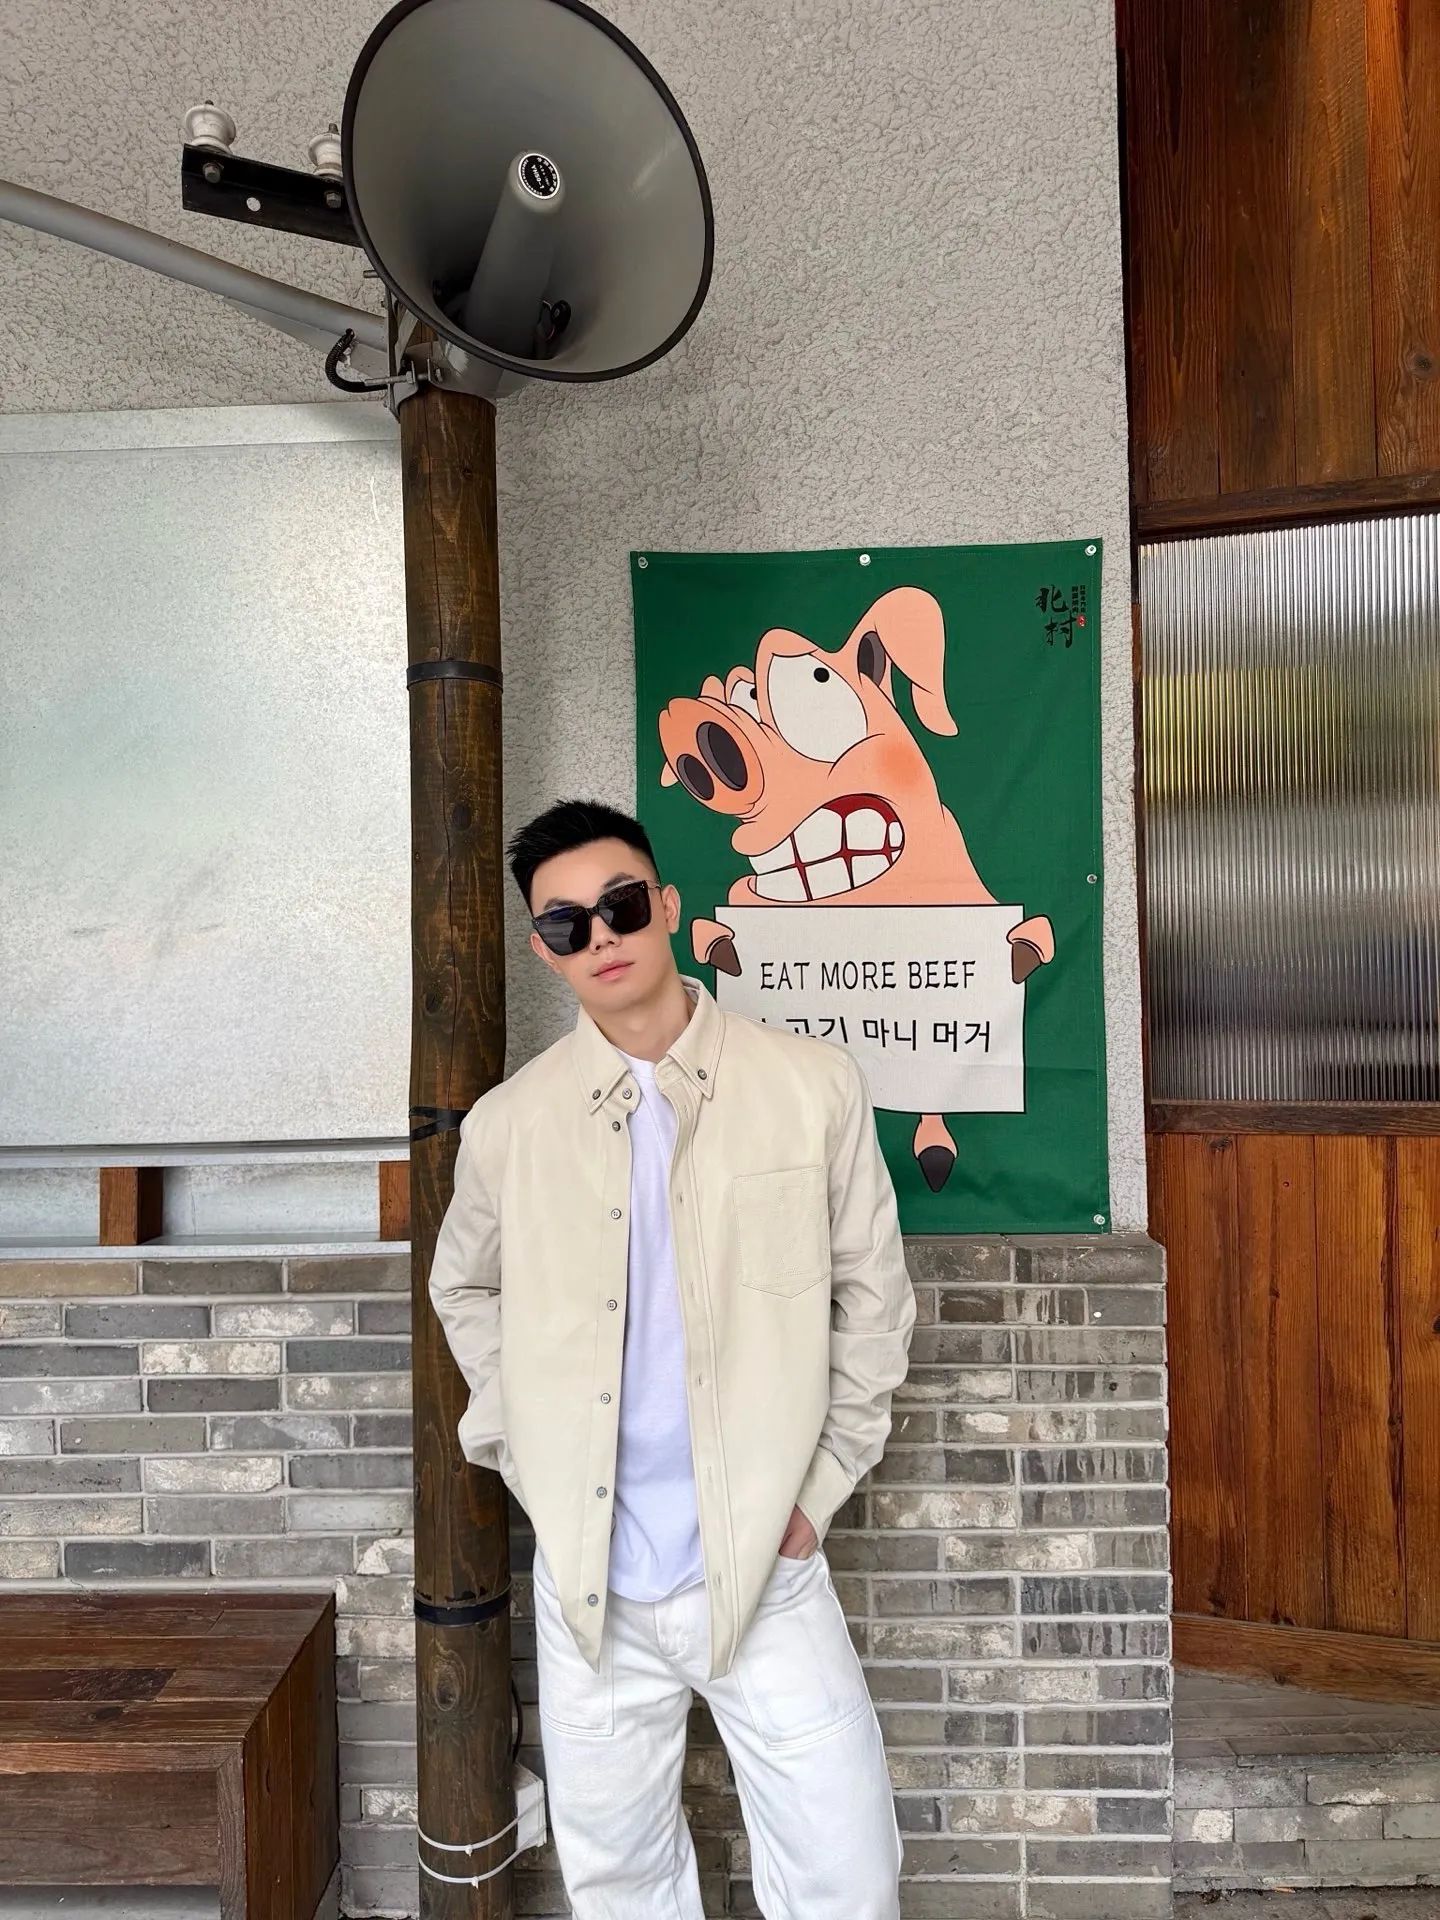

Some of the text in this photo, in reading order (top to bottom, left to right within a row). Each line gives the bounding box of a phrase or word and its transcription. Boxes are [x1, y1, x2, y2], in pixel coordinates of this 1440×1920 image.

[1035, 584, 1077, 649] 北村
[760, 960, 976, 990] EAT MORE BEEF
[761, 1016, 990, 1053] 고기 마니 머거
